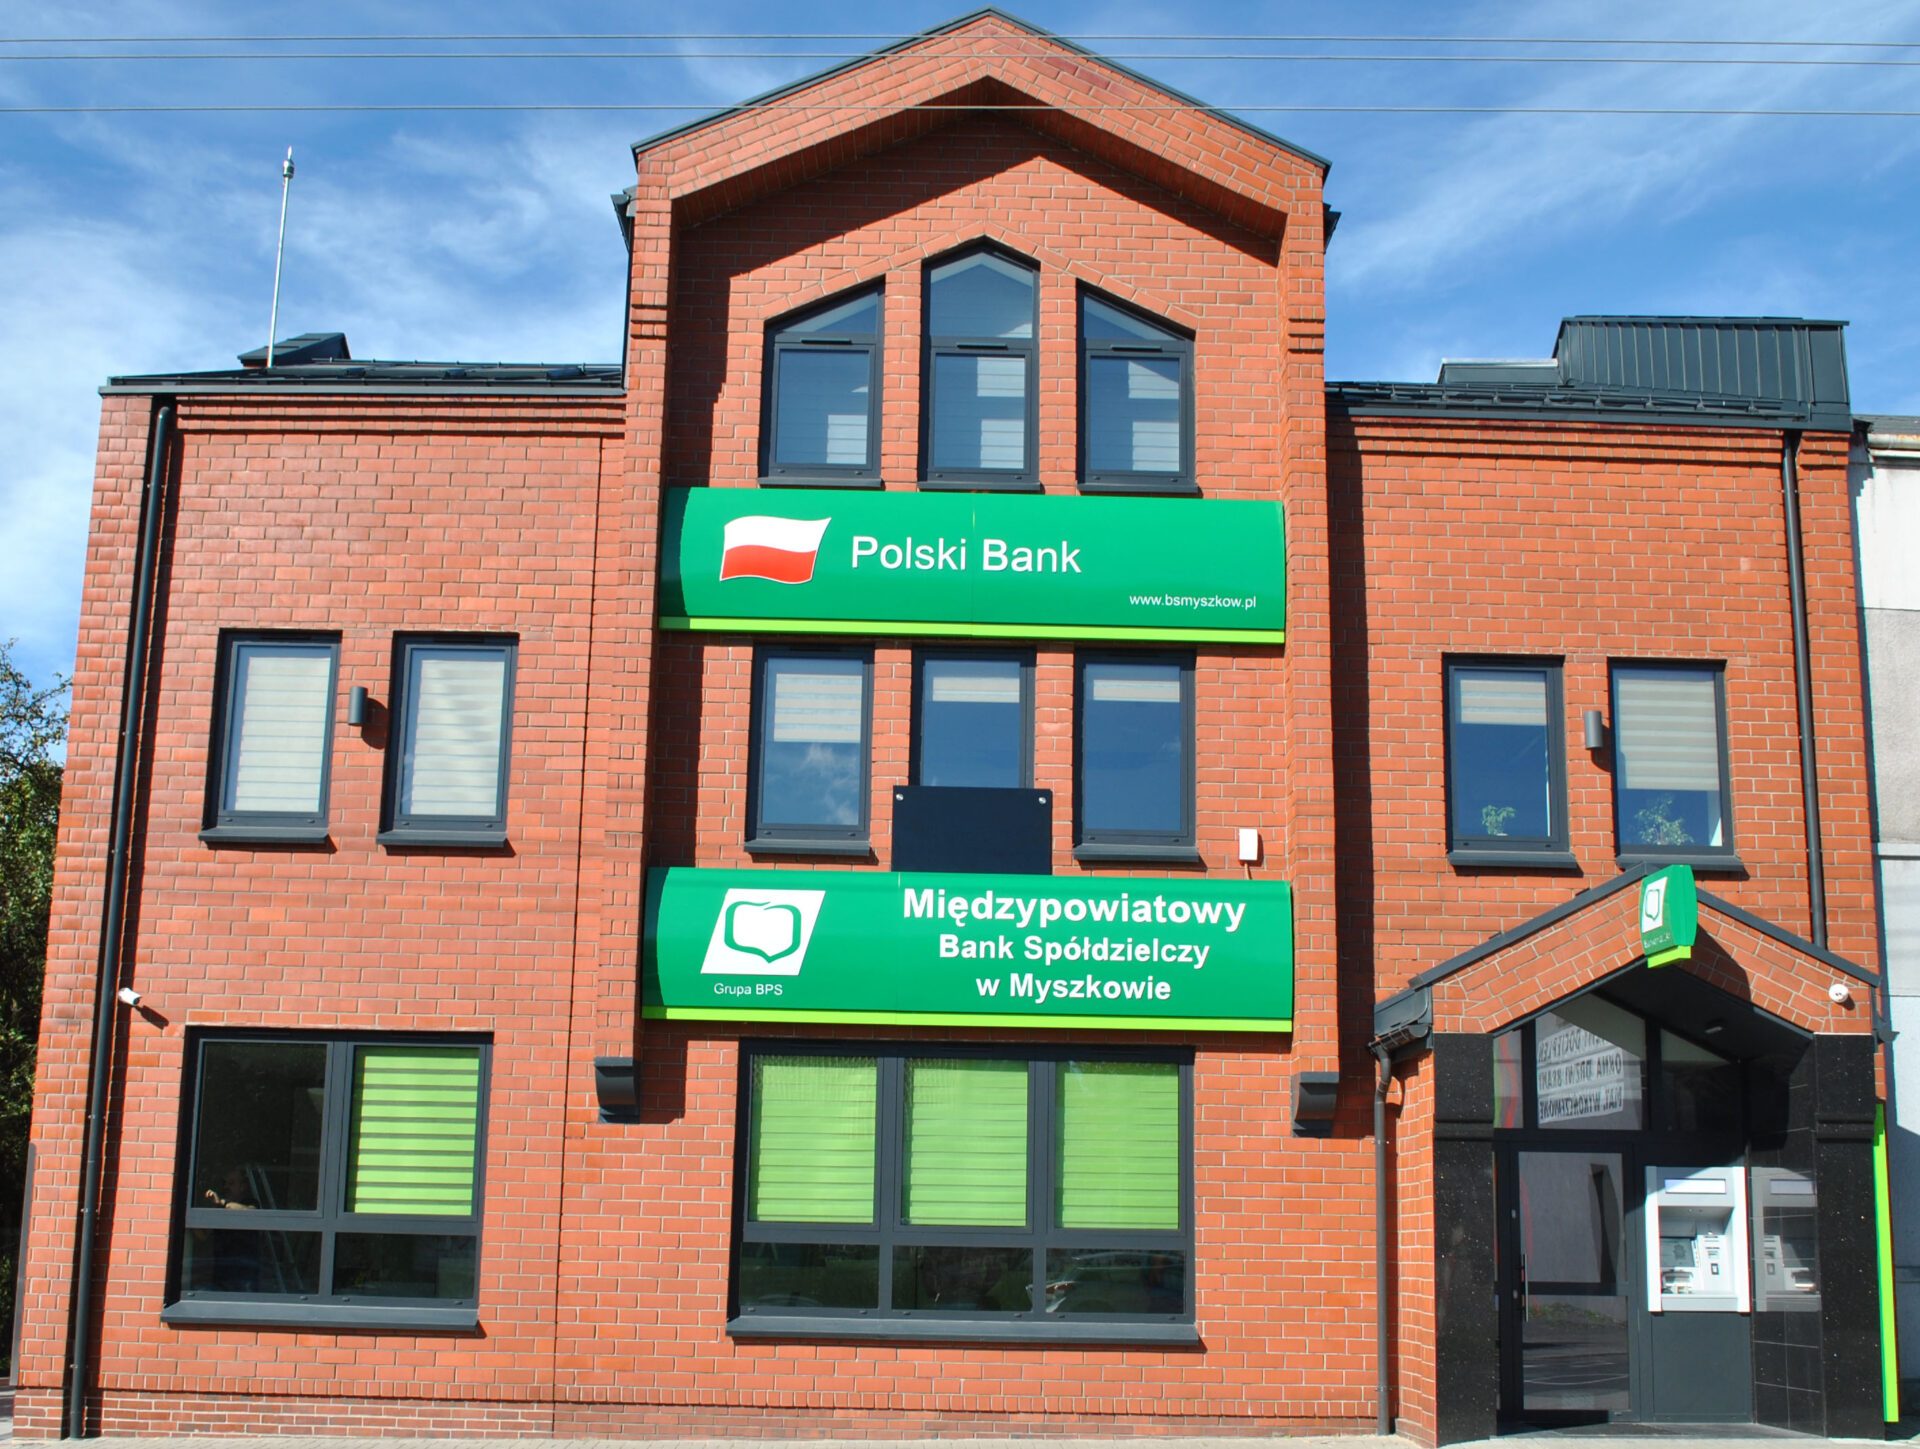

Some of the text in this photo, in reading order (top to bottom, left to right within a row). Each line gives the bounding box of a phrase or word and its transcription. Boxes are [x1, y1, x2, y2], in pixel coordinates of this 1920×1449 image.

[851, 535, 1082, 573] Polski Bank
[1129, 593, 1257, 610] www.bsmyszkow.pl
[903, 887, 1247, 933] Międzypowiatowy
[939, 933, 1211, 968] Bank Spółdzielczy
[713, 982, 784, 997] Grupa BPS
[975, 972, 1172, 1004] w Myszkowie
